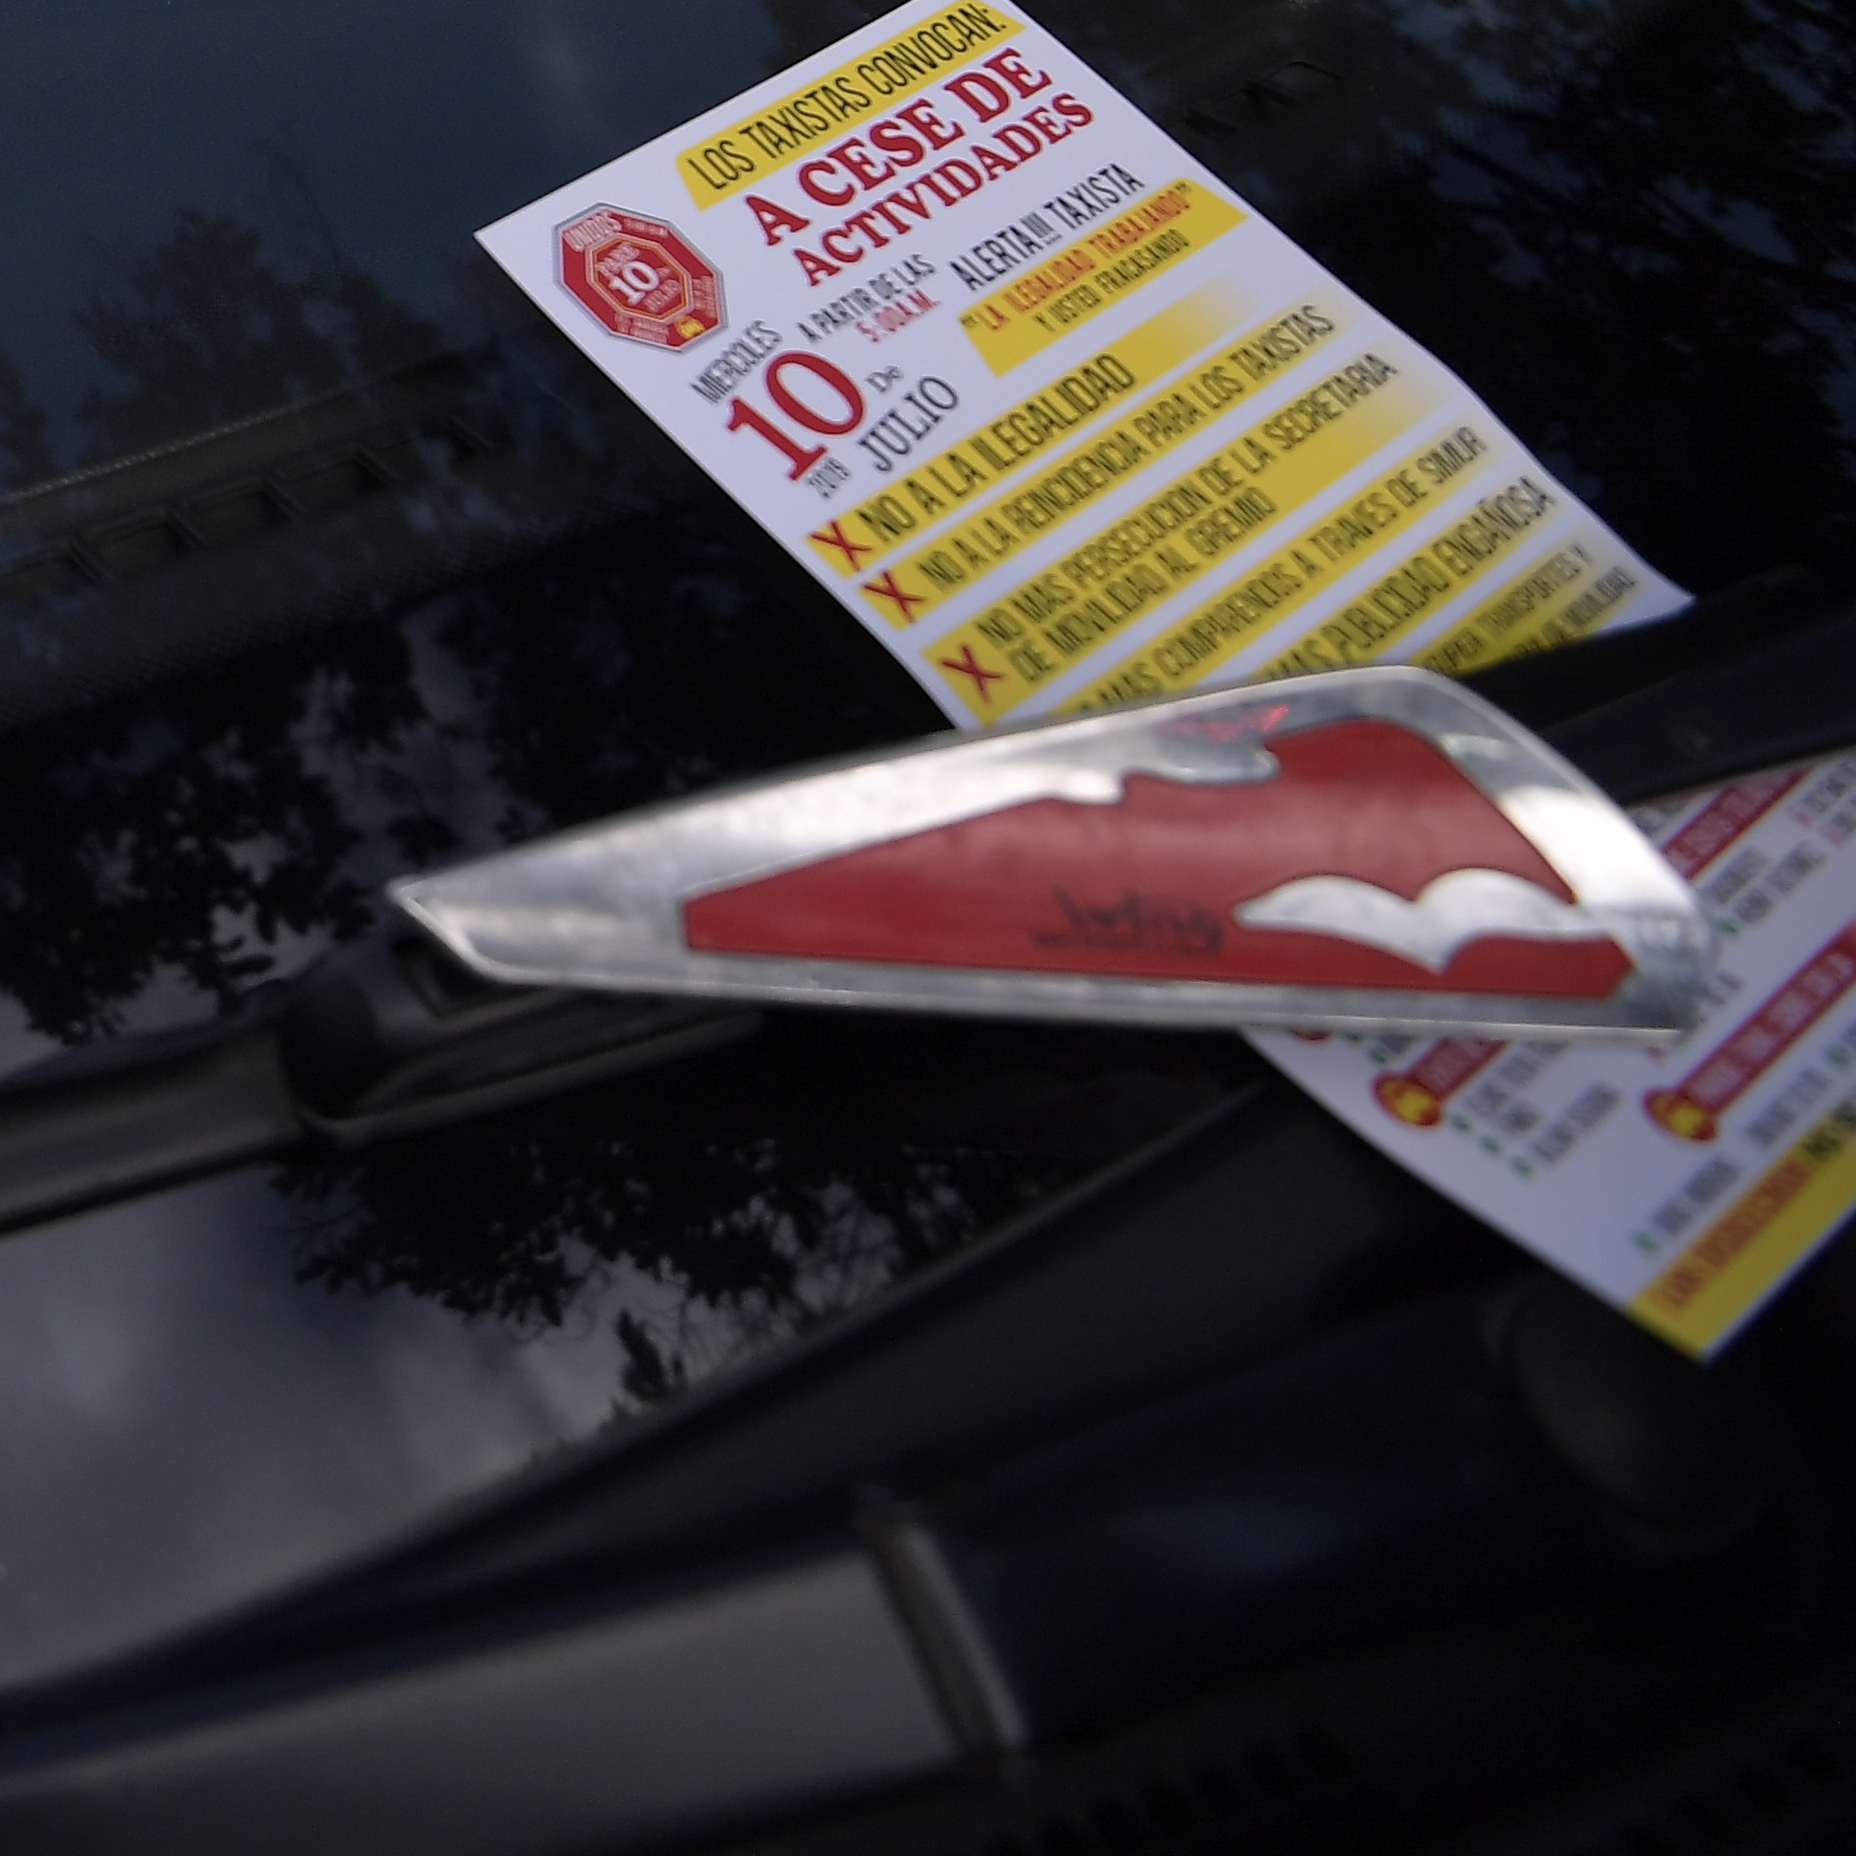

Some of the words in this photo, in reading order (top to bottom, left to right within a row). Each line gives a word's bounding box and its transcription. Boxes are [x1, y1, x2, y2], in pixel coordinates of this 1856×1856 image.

[688, 138, 755, 190] LOS
[739, 76, 872, 159] TAXISTAS
[857, 2, 1007, 95] CONVOCAN:
[745, 194, 810, 245] A
[798, 99, 965, 207] CESE
[943, 48, 1052, 123] DE
[794, 92, 1094, 286] ACTIVIDADES
[1044, 162, 1145, 230] TAXISTA
[608, 261, 659, 304] 10
[796, 321, 822, 343] A
[810, 287, 880, 335] PARTIR
[869, 273, 903, 300] DE
[890, 253, 937, 286] LAS
[1003, 248, 1096, 312] ILEGALIDAD
[1034, 313, 1056, 332] Y
[1049, 283, 1102, 324] USTED
[1095, 228, 1191, 294] FRACASANDO
[691, 319, 783, 404] MIERCOLES
[865, 365, 904, 393] De
[1188, 364, 1246, 411] LOS
[1228, 302, 1336, 383] TAXISTAS
[727, 350, 865, 481] 10
[855, 494, 917, 542] NO
[906, 478, 944, 514] A
[939, 451, 988, 499] LA
[974, 351, 1136, 472] ILEGALIDAD
[857, 375, 959, 472] JULIO
[1133, 393, 1207, 447] PARA
[974, 606, 1025, 648] NO
[1012, 573, 1076, 627] MAS
[1061, 483, 1213, 589] PERSECUCION
[1198, 457, 1243, 498] DE
[1231, 435, 1277, 476] LA
[1261, 351, 1399, 452] SECRETARIA
[1001, 429, 1148, 536] REINCIDENCIA
[917, 548, 967, 592] NO
[955, 537, 985, 570] A
[969, 516, 1016, 557] LA
[1151, 560, 1307, 679] COMPARENDOS
[1291, 549, 1325, 580] A
[1309, 491, 1400, 562] TRAVES
[1386, 469, 1429, 508] DE
[1008, 646, 1055, 685] DE
[1044, 563, 1170, 656] MOVILIDAD
[1156, 546, 1200, 579] AL
[1183, 485, 1278, 557] GREMIO
[1321, 554, 1452, 666] PUBLICIDAD
